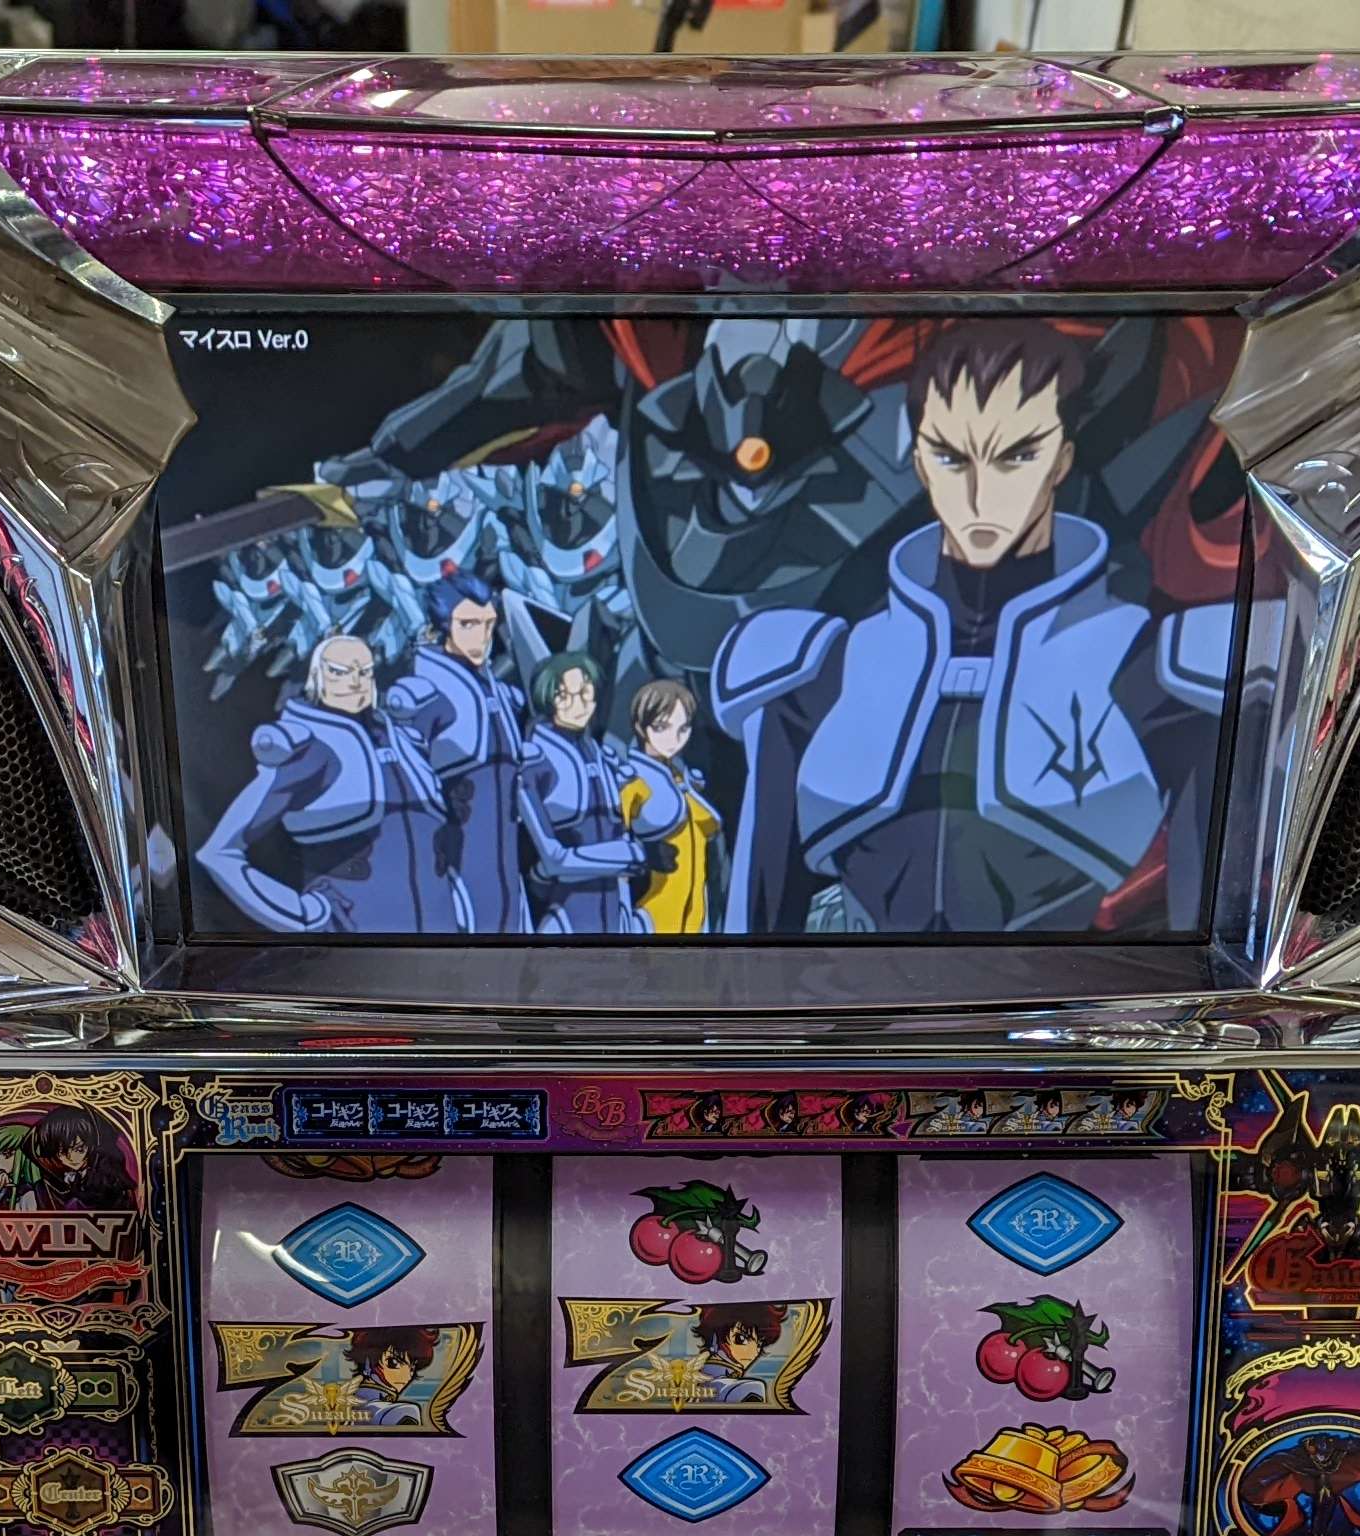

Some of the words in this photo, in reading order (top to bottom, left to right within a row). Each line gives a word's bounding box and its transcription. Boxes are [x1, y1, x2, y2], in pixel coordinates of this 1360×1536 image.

[178, 328, 252, 351] マイスロ
[257, 329, 309, 349] Ver.0
[617, 1367, 717, 1402] Suzaku
[272, 1391, 372, 1425] Suzaku
[40, 1482, 103, 1504] Center
